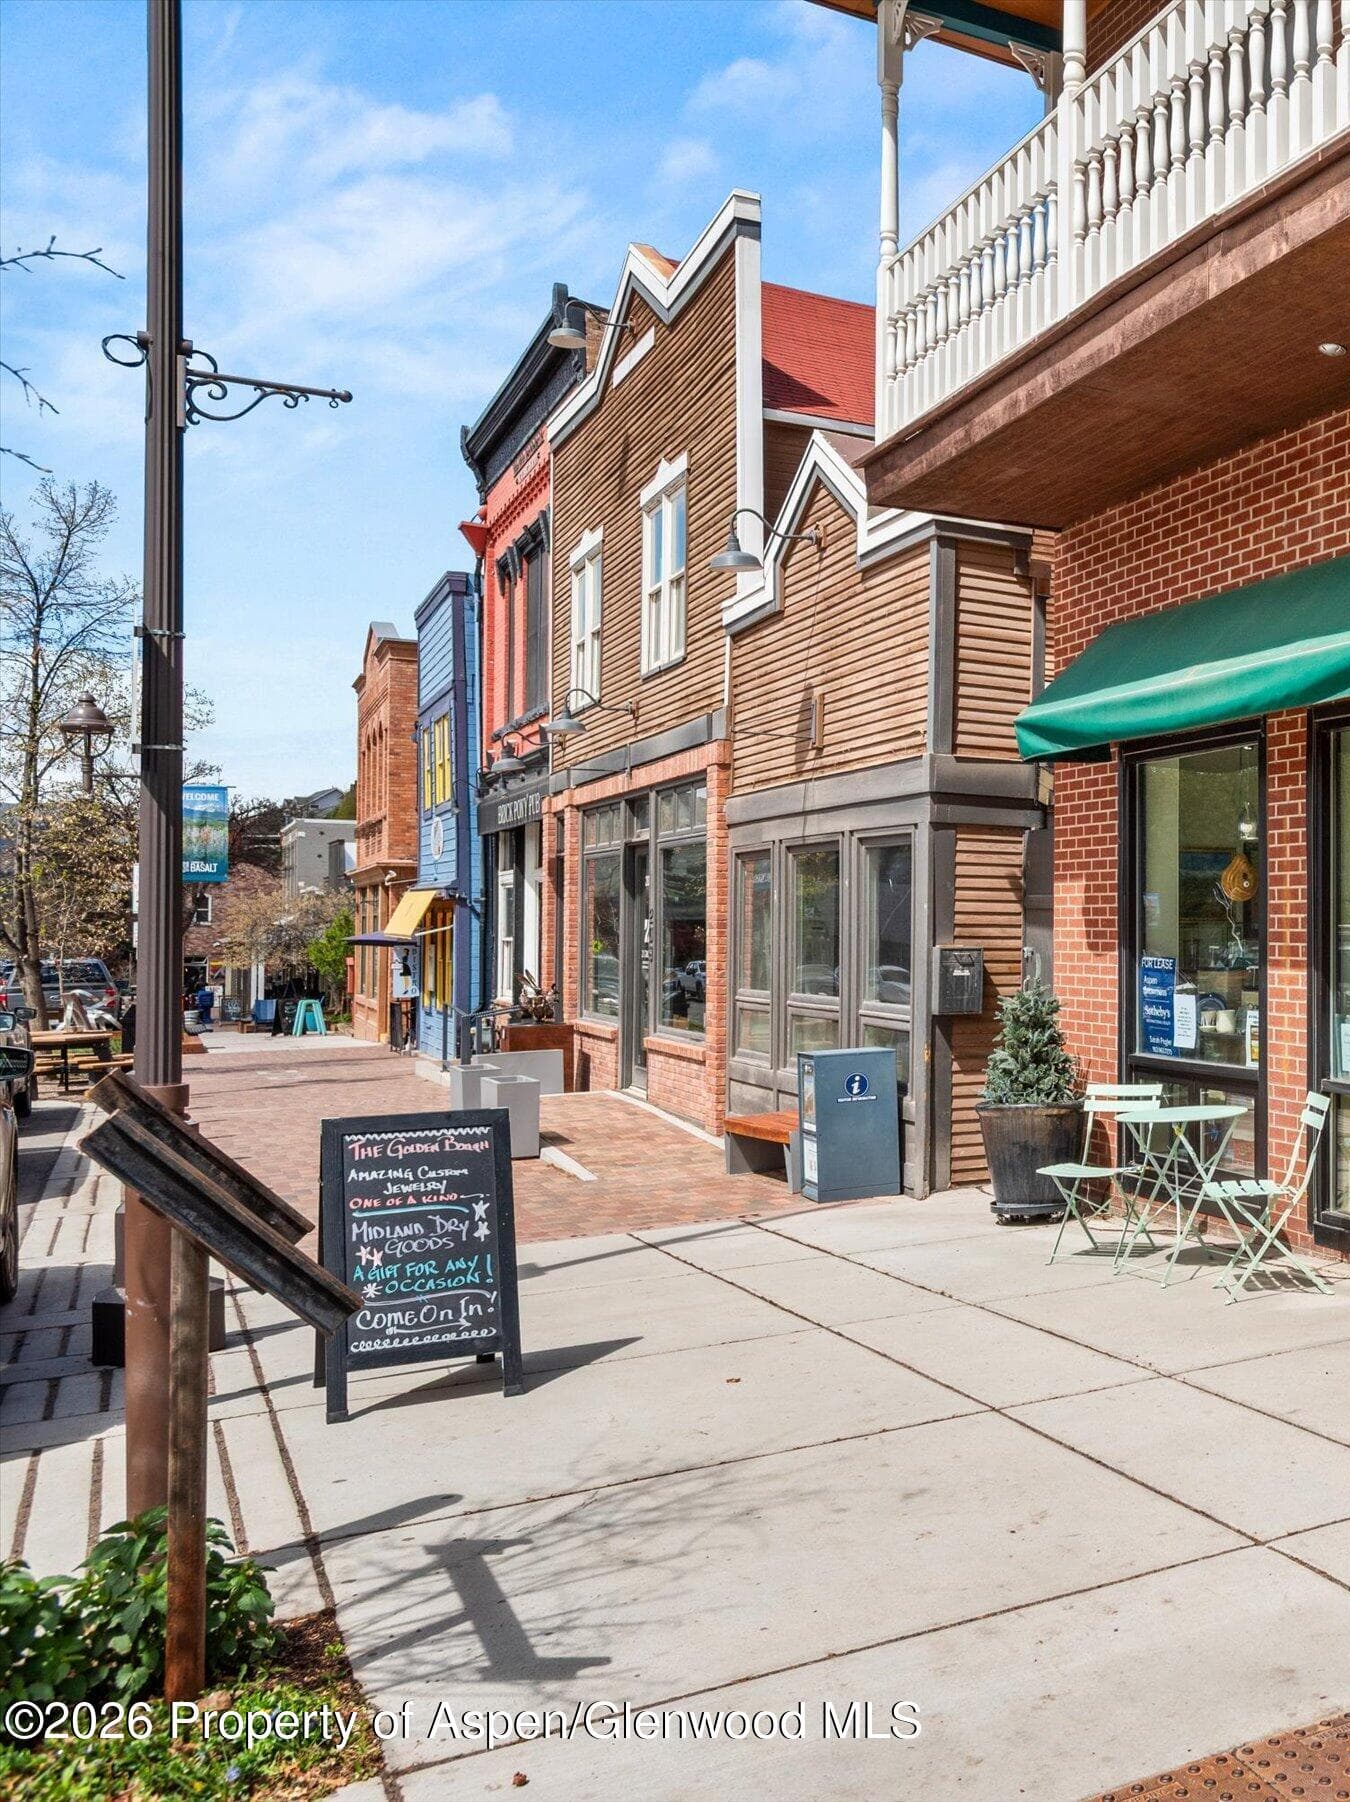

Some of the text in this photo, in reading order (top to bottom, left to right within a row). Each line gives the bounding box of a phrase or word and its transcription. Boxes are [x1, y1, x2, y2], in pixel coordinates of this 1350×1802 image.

[190, 862, 218, 873] BASALT
[1141, 959, 1173, 970] FOR LEASE
[349, 1136, 490, 1161] THE GOLDEN BOUGH
[347, 1165, 469, 1183] AMAZING CUSTOM
[382, 1180, 448, 1195] JEWELRY
[349, 1193, 459, 1210] ONE OF A KIND
[352, 1215, 470, 1243] MIDLAND DRY
[384, 1237, 455, 1258] GOODS
[353, 1254, 478, 1283] A GIFT FOR ANY
